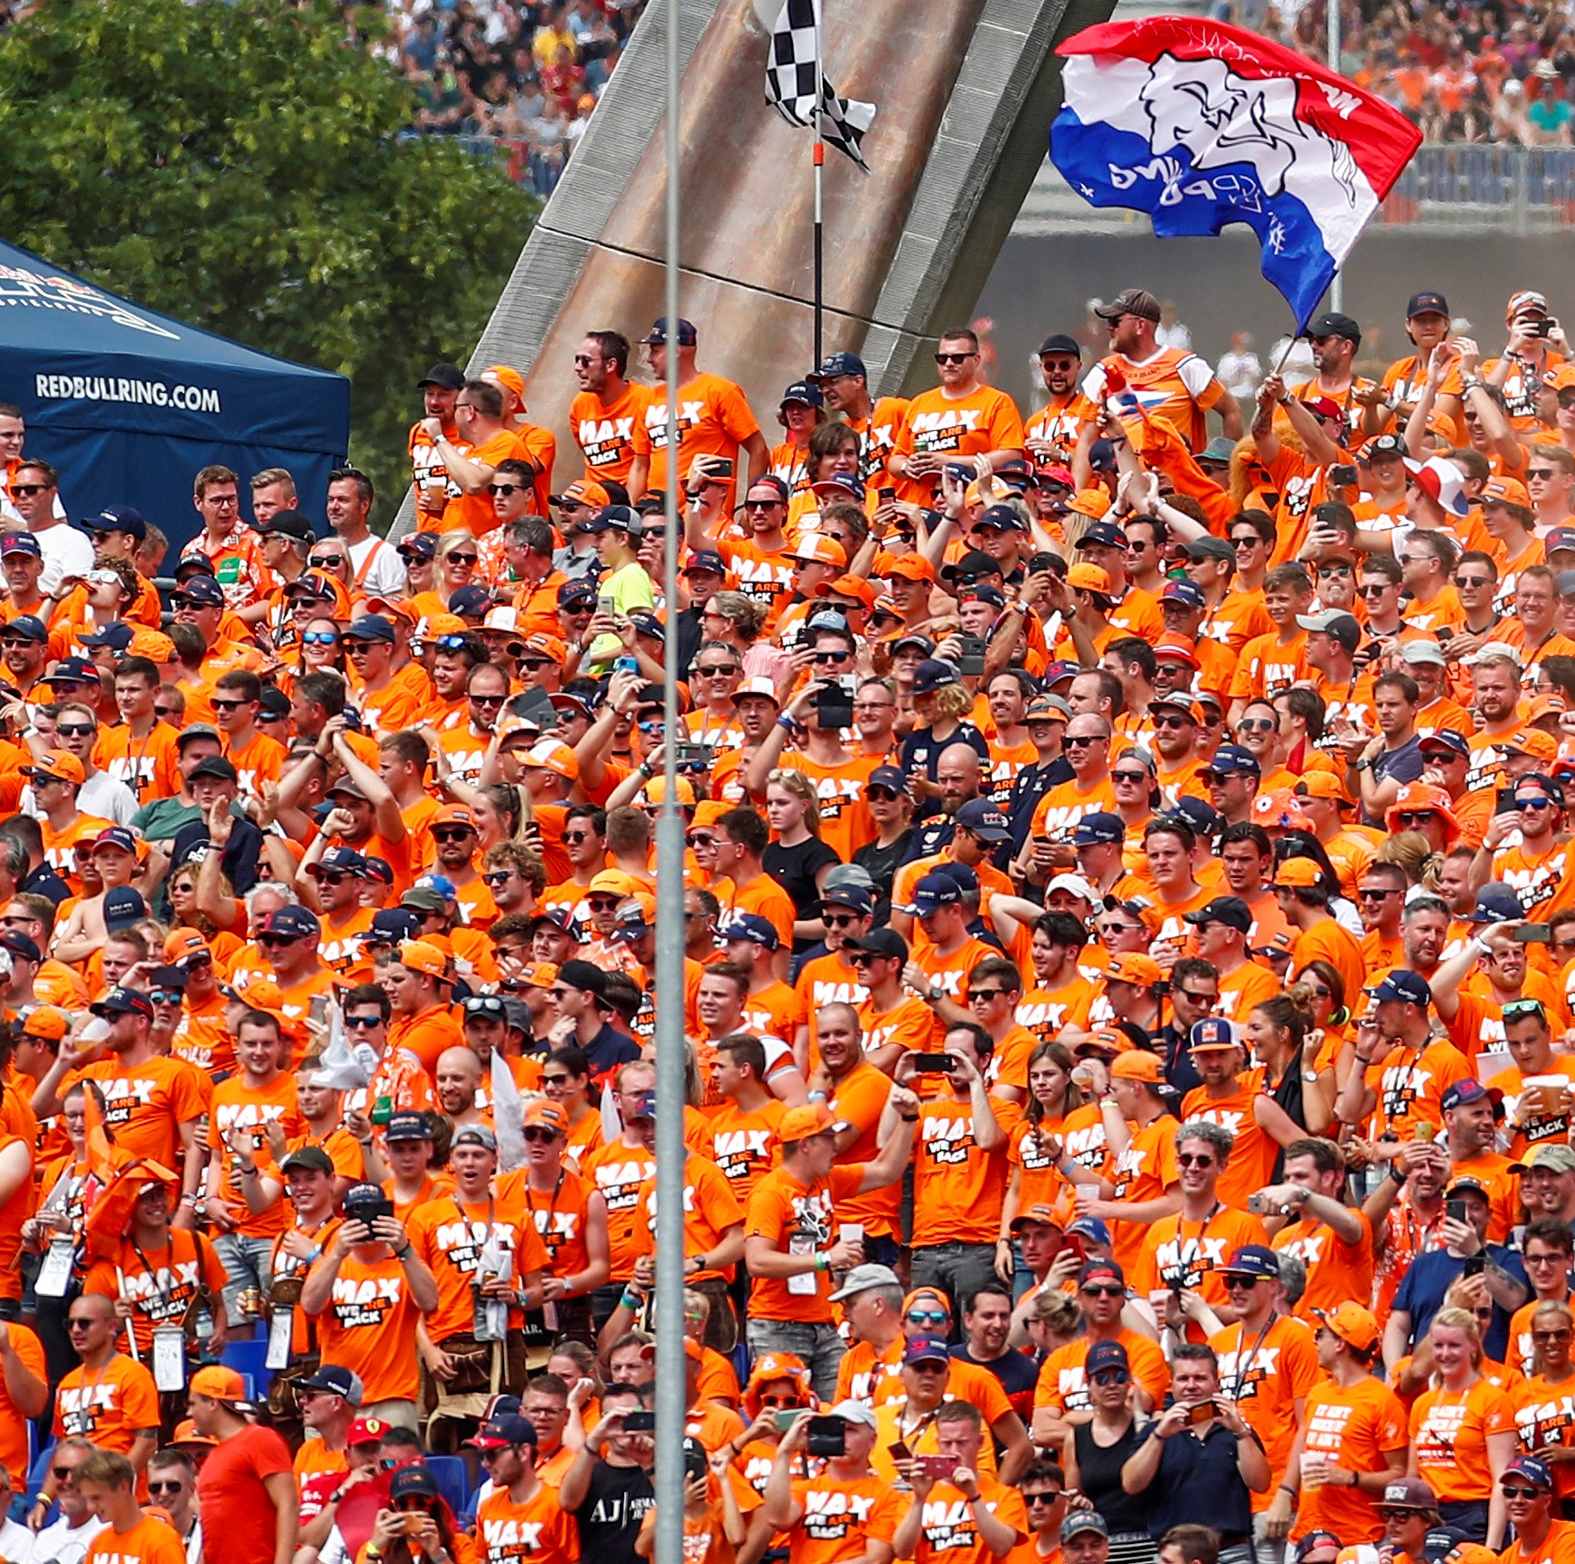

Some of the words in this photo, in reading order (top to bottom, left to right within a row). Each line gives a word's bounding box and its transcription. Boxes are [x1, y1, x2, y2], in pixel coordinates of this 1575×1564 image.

[36, 373, 220, 413] REDBULLRING.COM
[579, 418, 633, 443] MAX
[913, 410, 981, 433] MAX
[928, 437, 957, 450] BACK
[590, 451, 619, 464] BACK
[732, 555, 794, 589] MAX
[755, 583, 780, 593] ARE
[1014, 1004, 1067, 1027] MAX
[218, 1105, 286, 1127] MAX
[714, 1130, 771, 1157] MAX
[929, 1140, 947, 1152] WE
[937, 1151, 967, 1163] BACK
[334, 1278, 402, 1303] MAX
[338, 1305, 360, 1317] WE
[365, 1298, 390, 1310] ARE
[345, 1311, 381, 1325] BACK
[631, 1498, 658, 1509] ARMA
[484, 1521, 544, 1548] MAX
[811, 1525, 844, 1537] BACK
[936, 1535, 972, 1549] BACK
